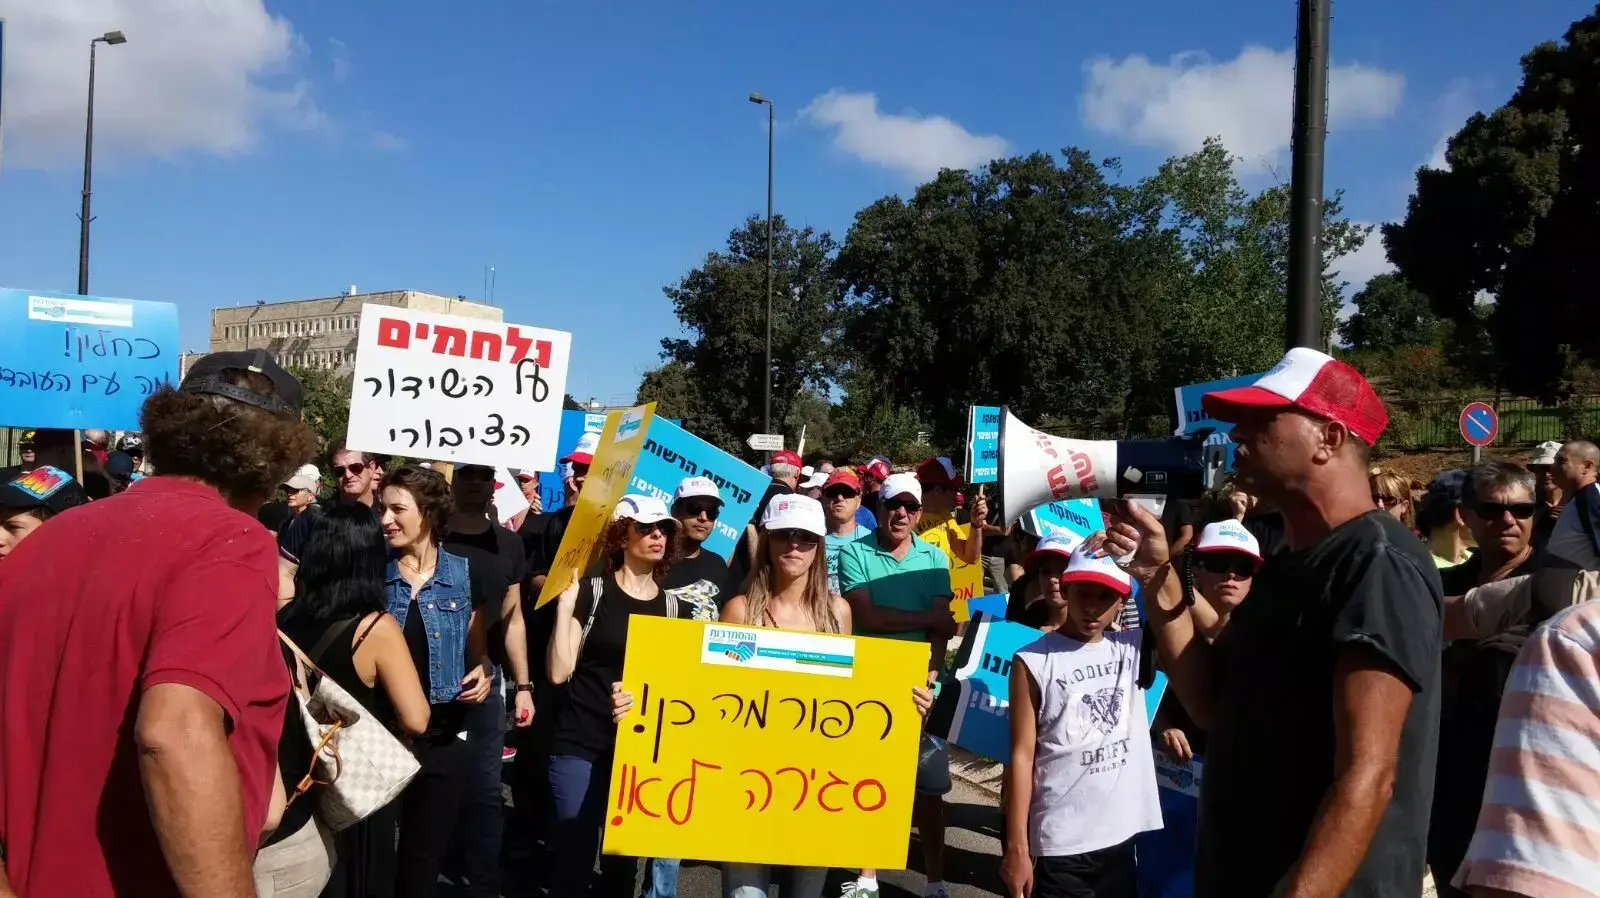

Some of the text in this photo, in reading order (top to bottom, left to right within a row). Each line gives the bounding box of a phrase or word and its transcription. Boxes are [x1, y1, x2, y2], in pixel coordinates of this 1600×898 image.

[377, 317, 553, 369] נלחמים
[82, 371, 120, 395] עם
[363, 358, 549, 402] על השידור
[389, 413, 531, 449] הציבורי
[643, 438, 698, 475] הרשות
[633, 683, 696, 763] כן!
[1080, 738, 1130, 767] DRIFT
[611, 758, 887, 826] סגירה לא!
